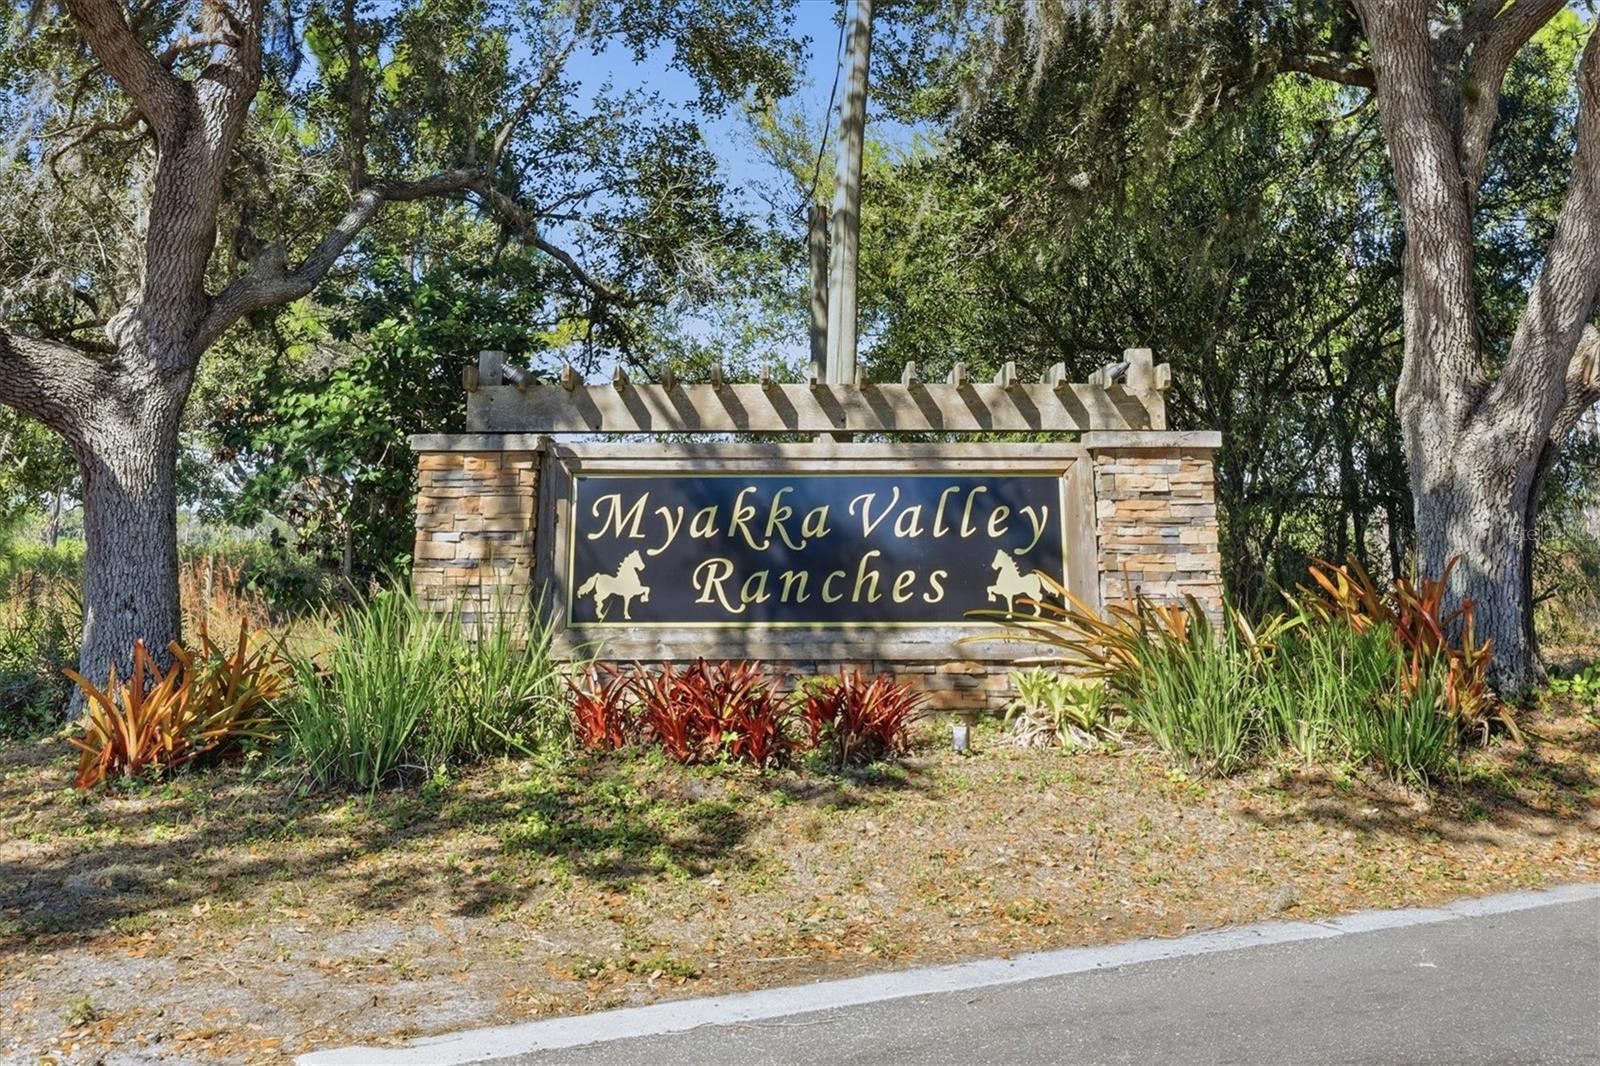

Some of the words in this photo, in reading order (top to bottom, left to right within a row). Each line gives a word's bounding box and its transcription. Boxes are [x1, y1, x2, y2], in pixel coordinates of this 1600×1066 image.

[587, 486, 831, 556] Myakka
[849, 486, 1049, 556] Valley
[692, 550, 948, 614] Ranches
